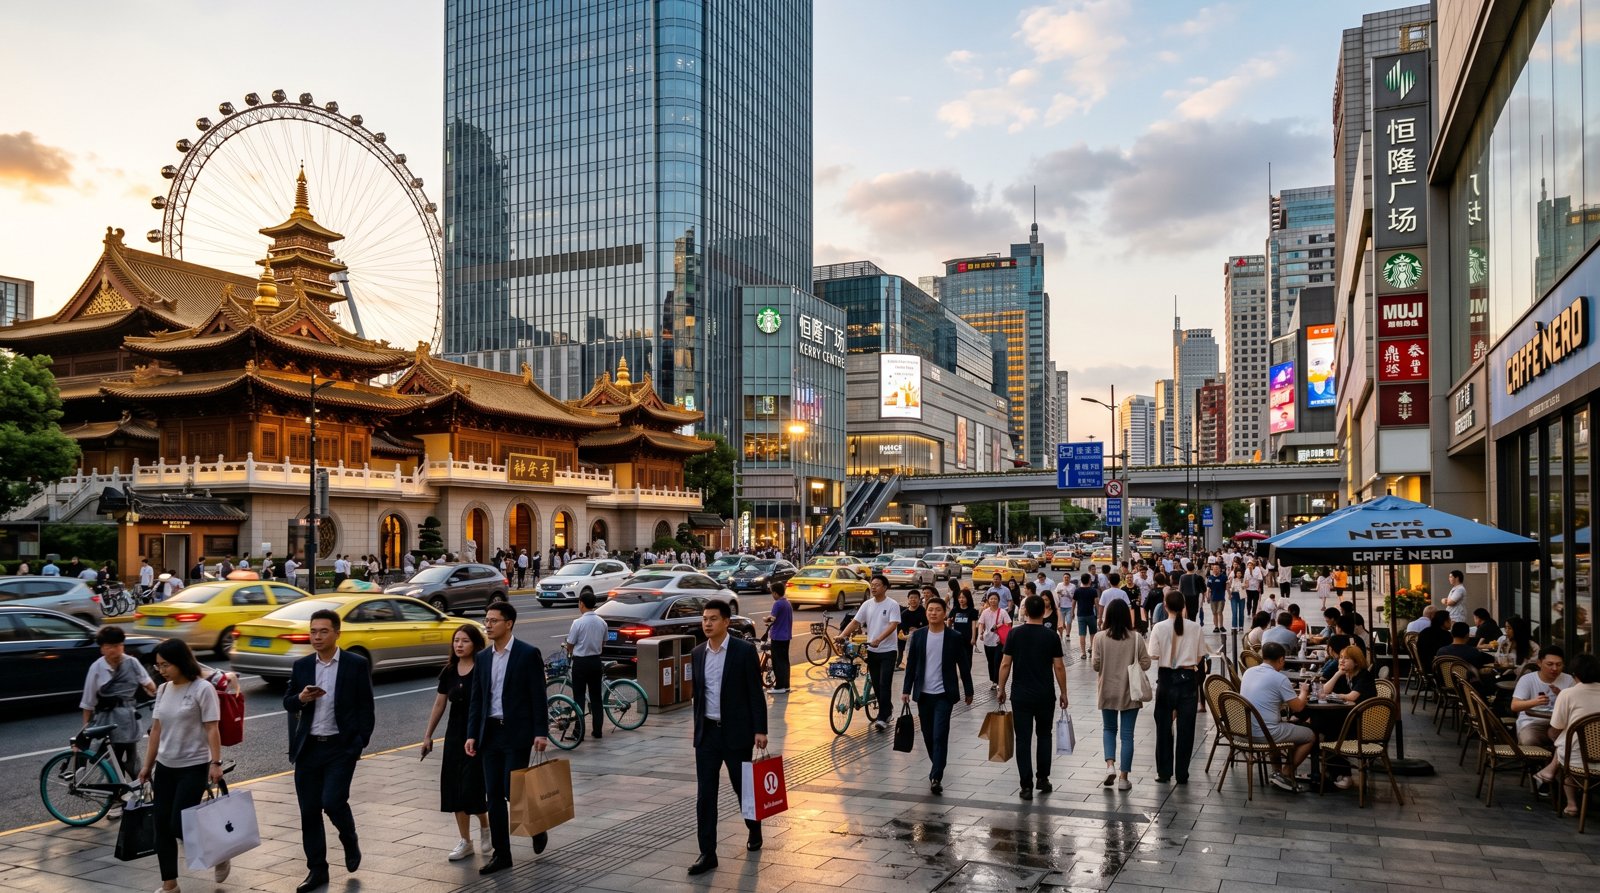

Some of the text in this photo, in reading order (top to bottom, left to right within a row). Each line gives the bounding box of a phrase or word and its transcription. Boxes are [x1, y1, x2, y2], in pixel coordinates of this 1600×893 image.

[1386, 118, 1417, 233] 恒隆广场
[1383, 302, 1423, 320] MUJI
[799, 313, 845, 353] 恒隆广场
[1542, 297, 1585, 369] NERO
[799, 341, 845, 369] KERRY CENTRE
[1348, 528, 1453, 541] NERO
[1352, 548, 1454, 562] CAFFÈ NERO
